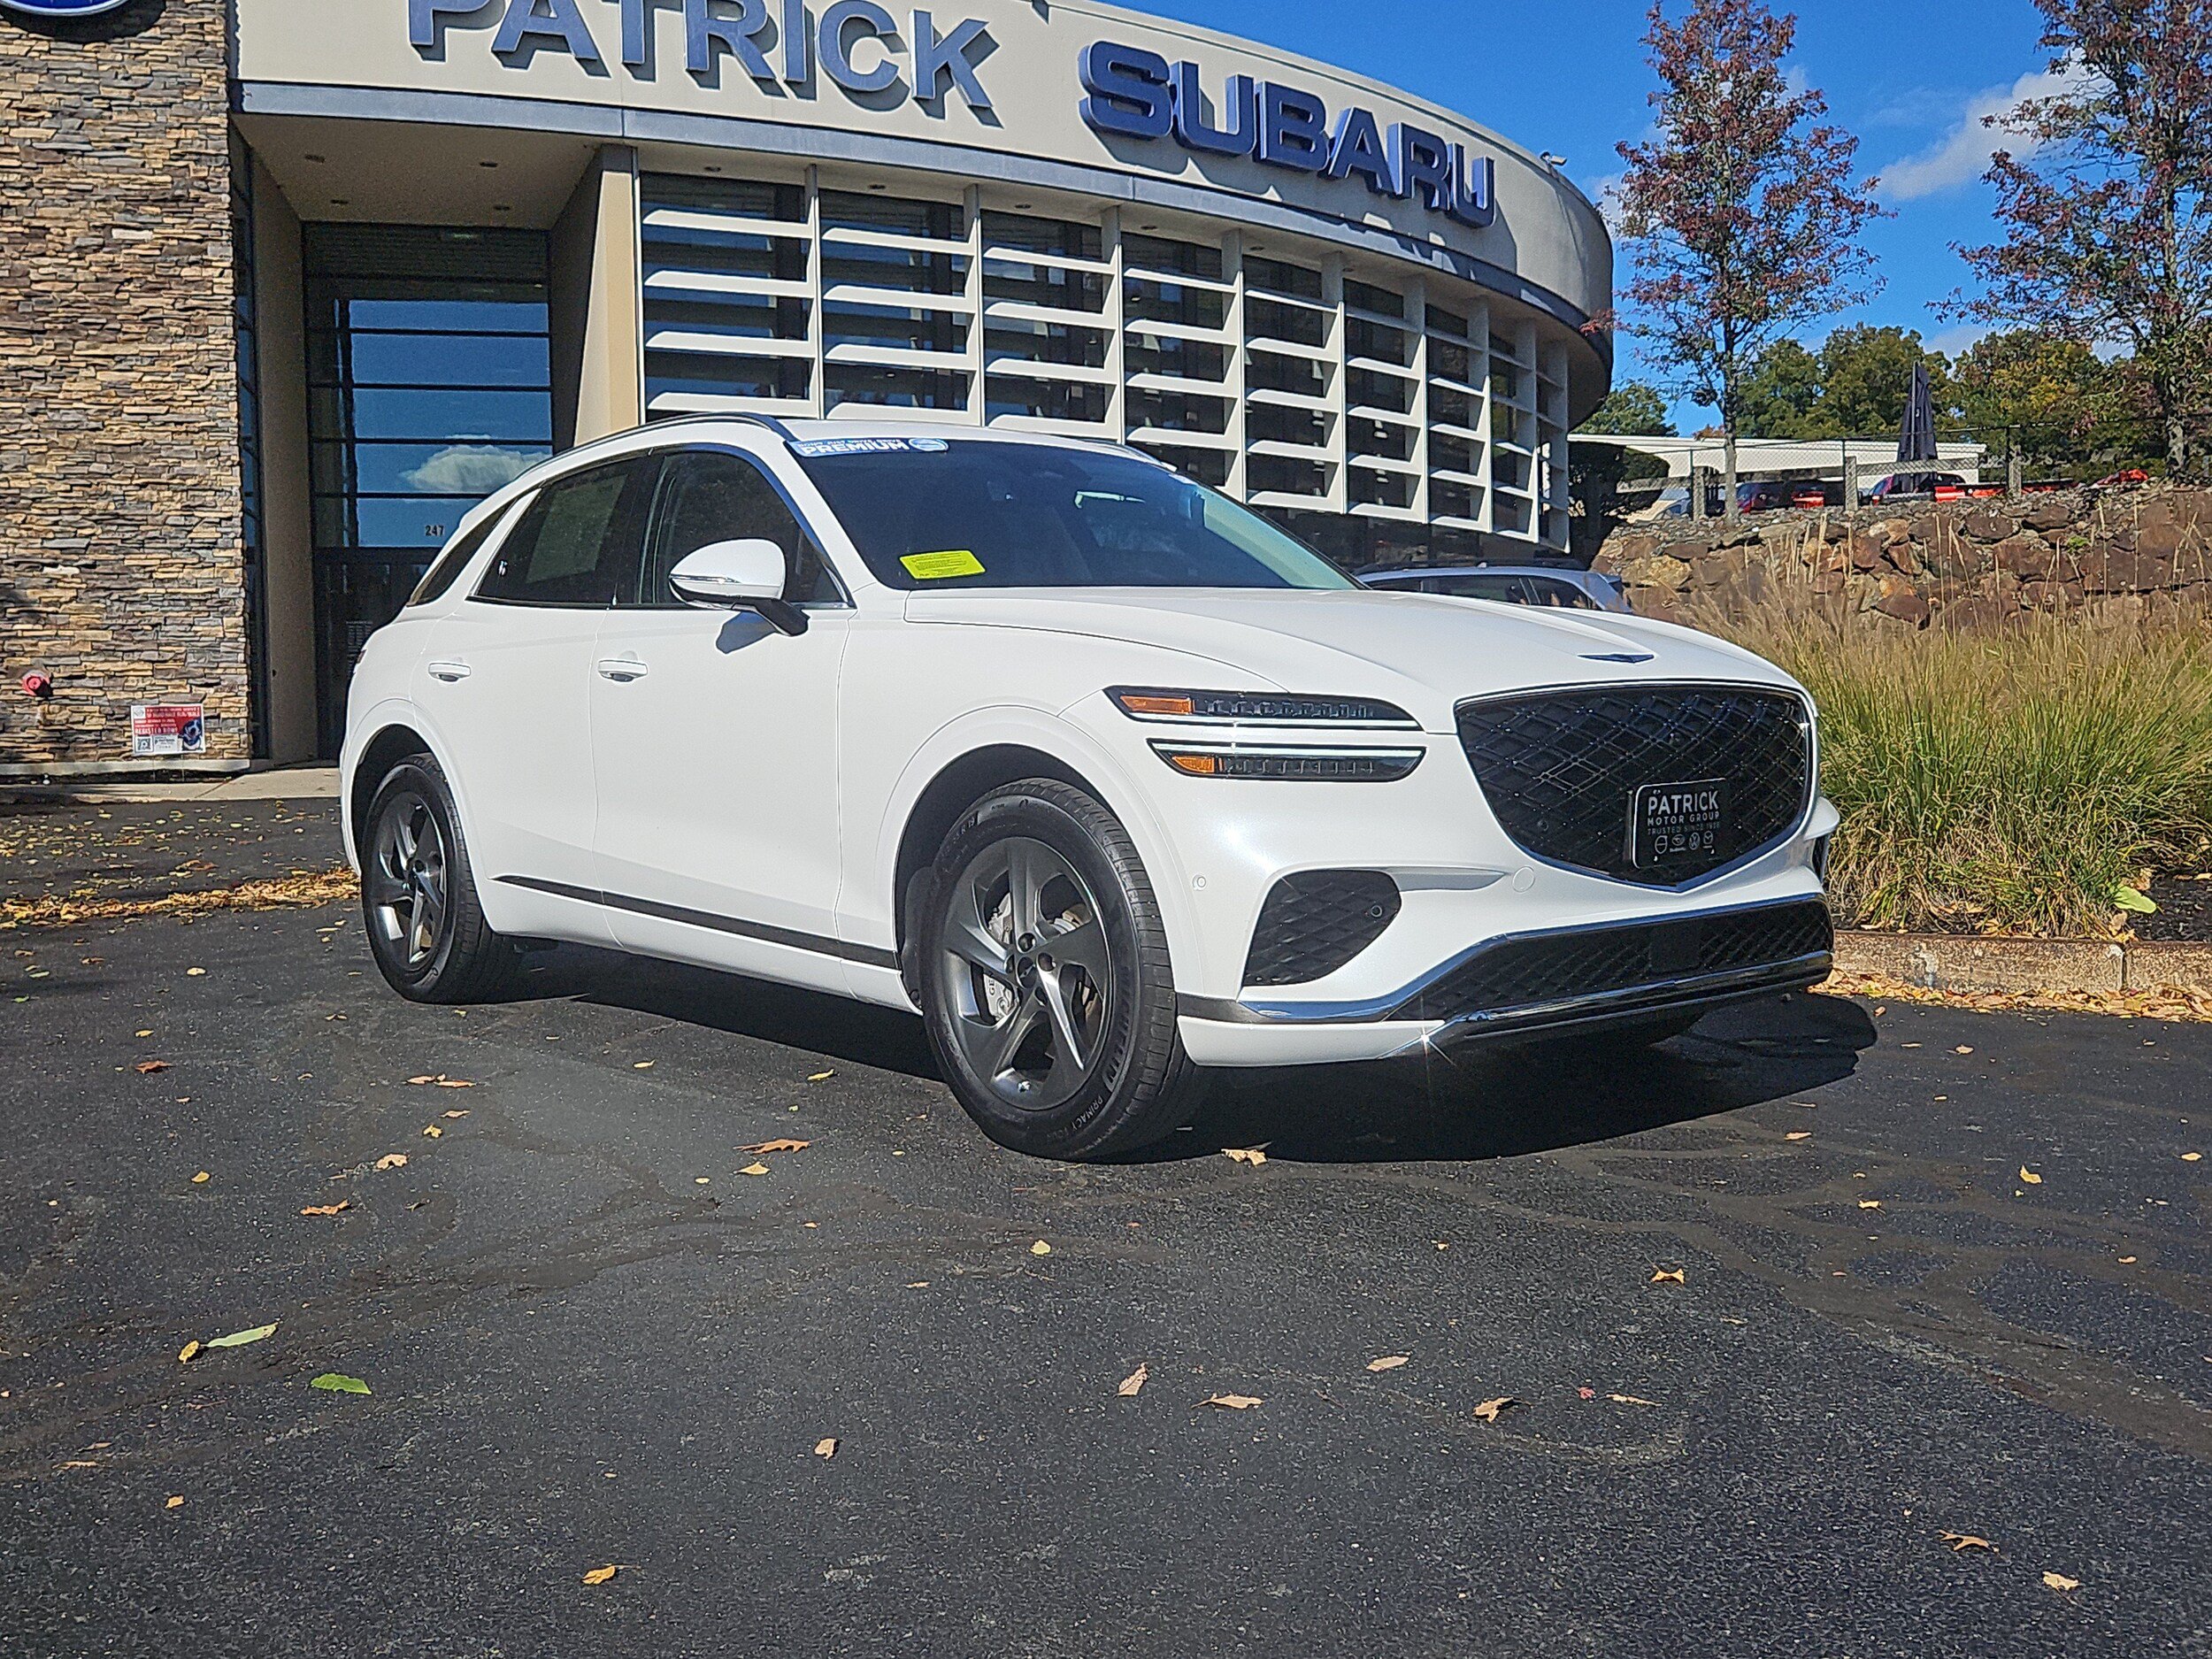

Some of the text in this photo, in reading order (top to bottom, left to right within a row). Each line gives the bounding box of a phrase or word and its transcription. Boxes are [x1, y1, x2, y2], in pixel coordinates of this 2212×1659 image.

[1079, 40, 1497, 228] SUBARU
[801, 442, 910, 455] PREMIUM
[425, 525, 444, 536] 247
[1647, 790, 1719, 816] PATRICK
[1647, 810, 1720, 826] MOTOR GROUP
[1647, 825, 1681, 835] TRUSTED
